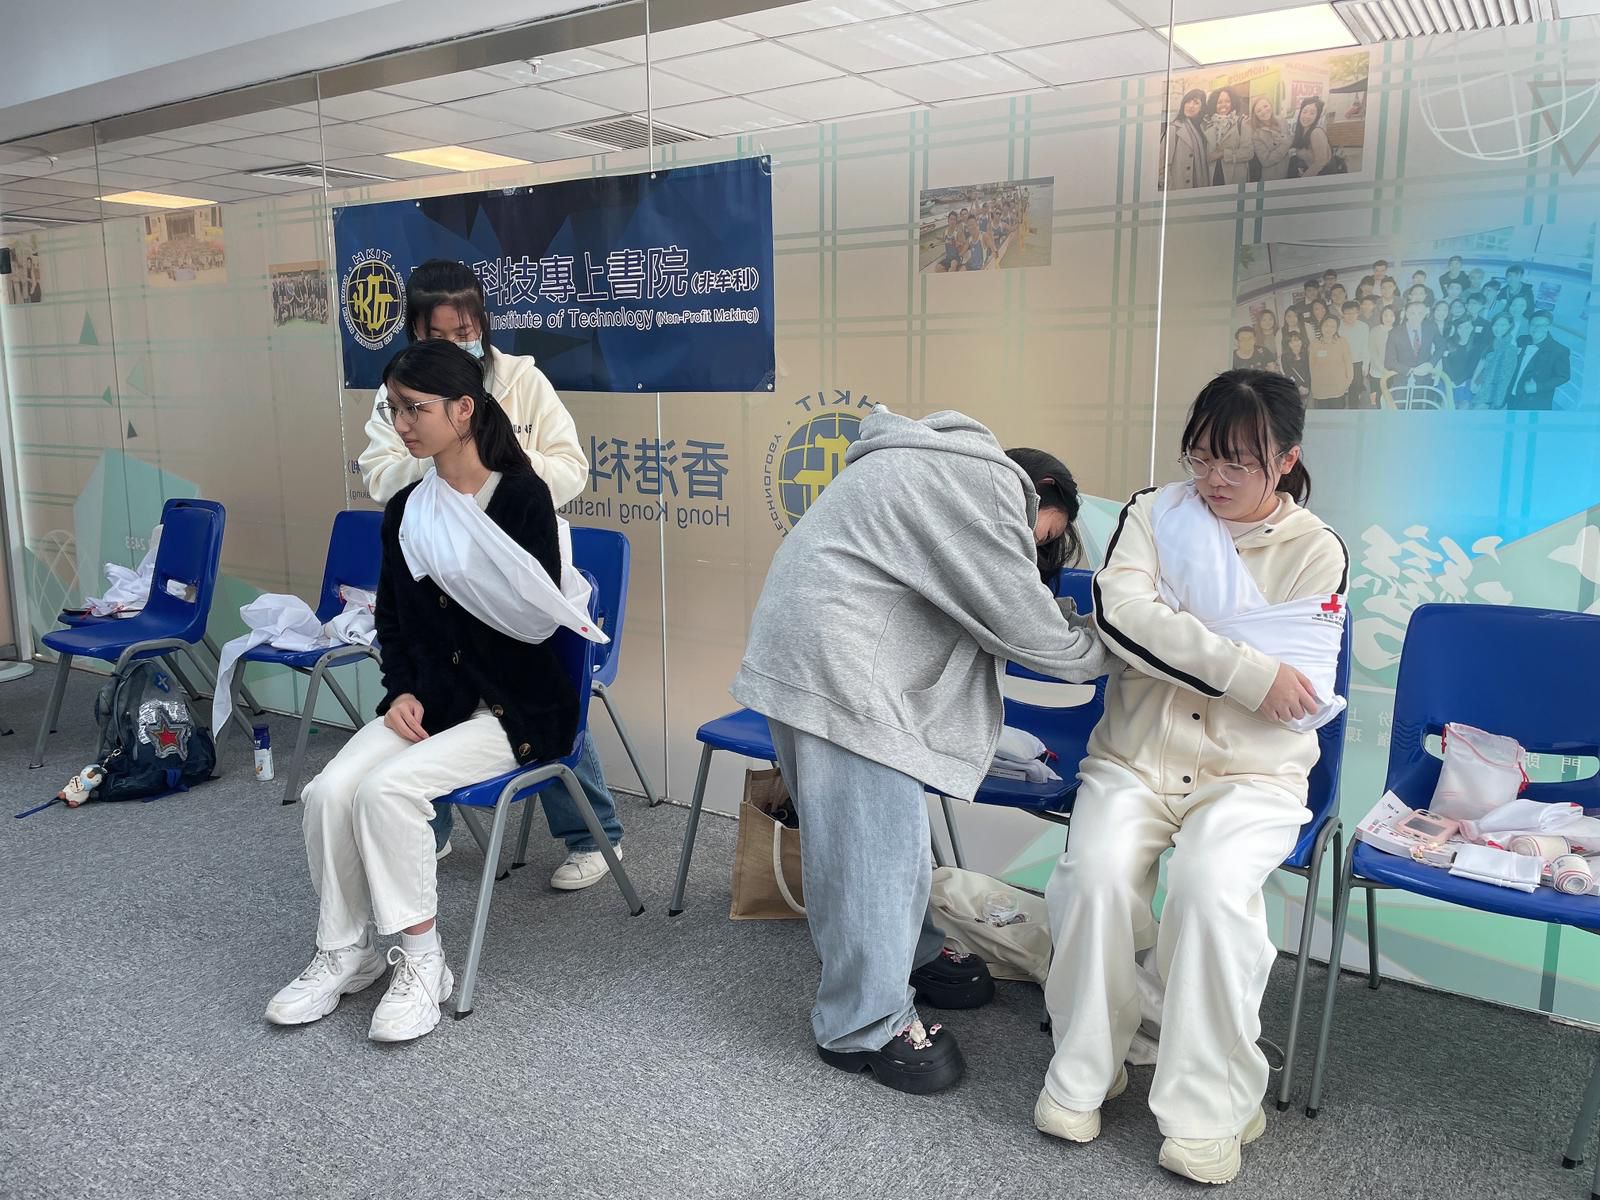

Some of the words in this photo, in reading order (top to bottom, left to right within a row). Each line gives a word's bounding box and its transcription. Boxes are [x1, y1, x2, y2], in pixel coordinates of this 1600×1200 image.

[352, 248, 391, 264] HKIT
[411, 245, 688, 306] 科技專上書院
[490, 310, 542, 330] Institute
[547, 309, 565, 328] of
[568, 306, 653, 331] Technology
[656, 308, 711, 327] (Non-Profit
[714, 307, 759, 324] Making)
